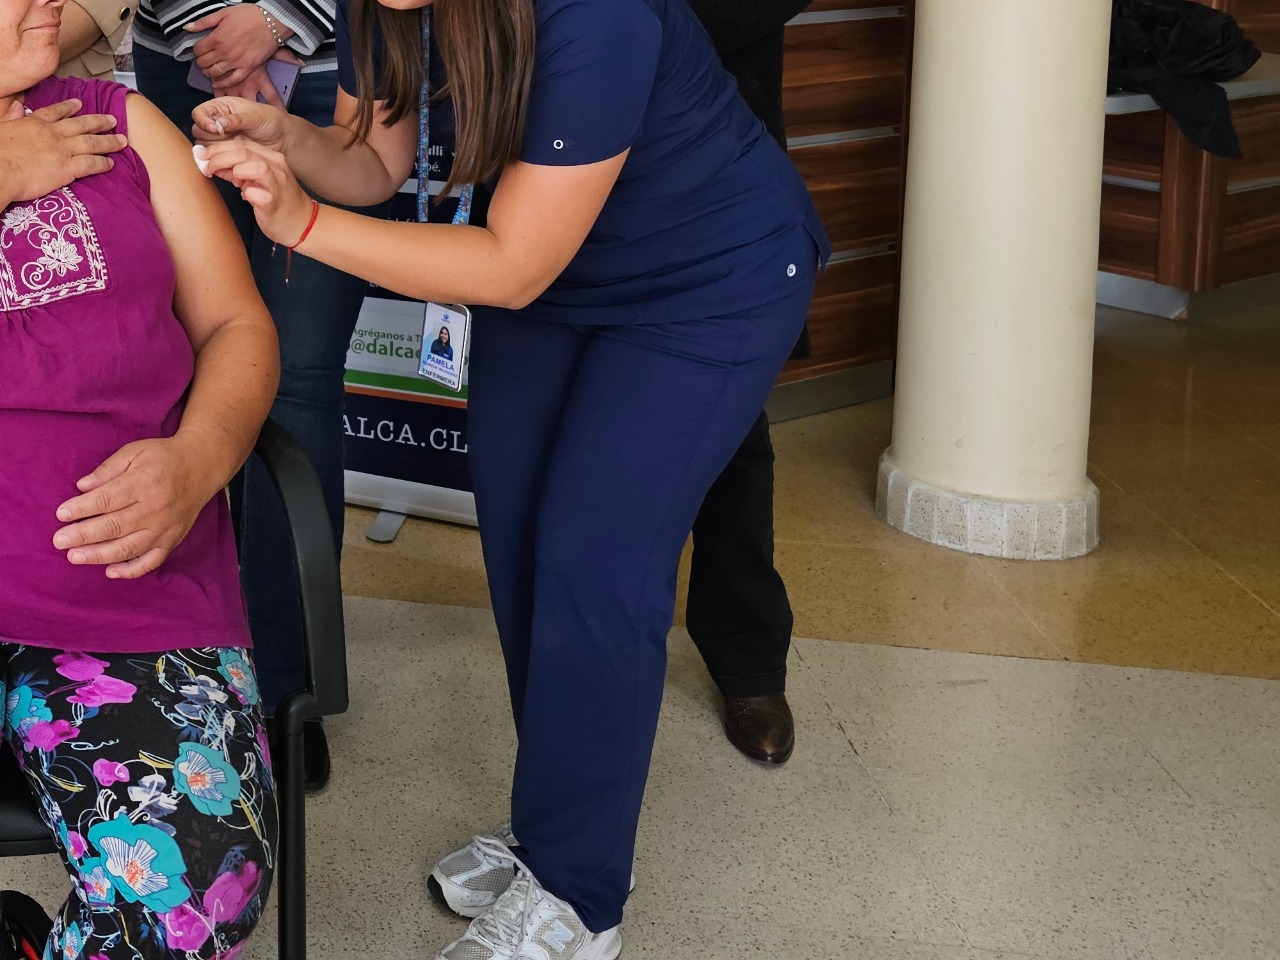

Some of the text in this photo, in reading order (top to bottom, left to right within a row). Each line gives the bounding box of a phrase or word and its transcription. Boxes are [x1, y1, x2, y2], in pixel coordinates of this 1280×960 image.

[352, 328, 405, 341] Agréganos
[427, 355, 455, 371] PAMELA
[423, 368, 456, 387] ENFERMERA
[342, 414, 468, 453] ALCA.CL
